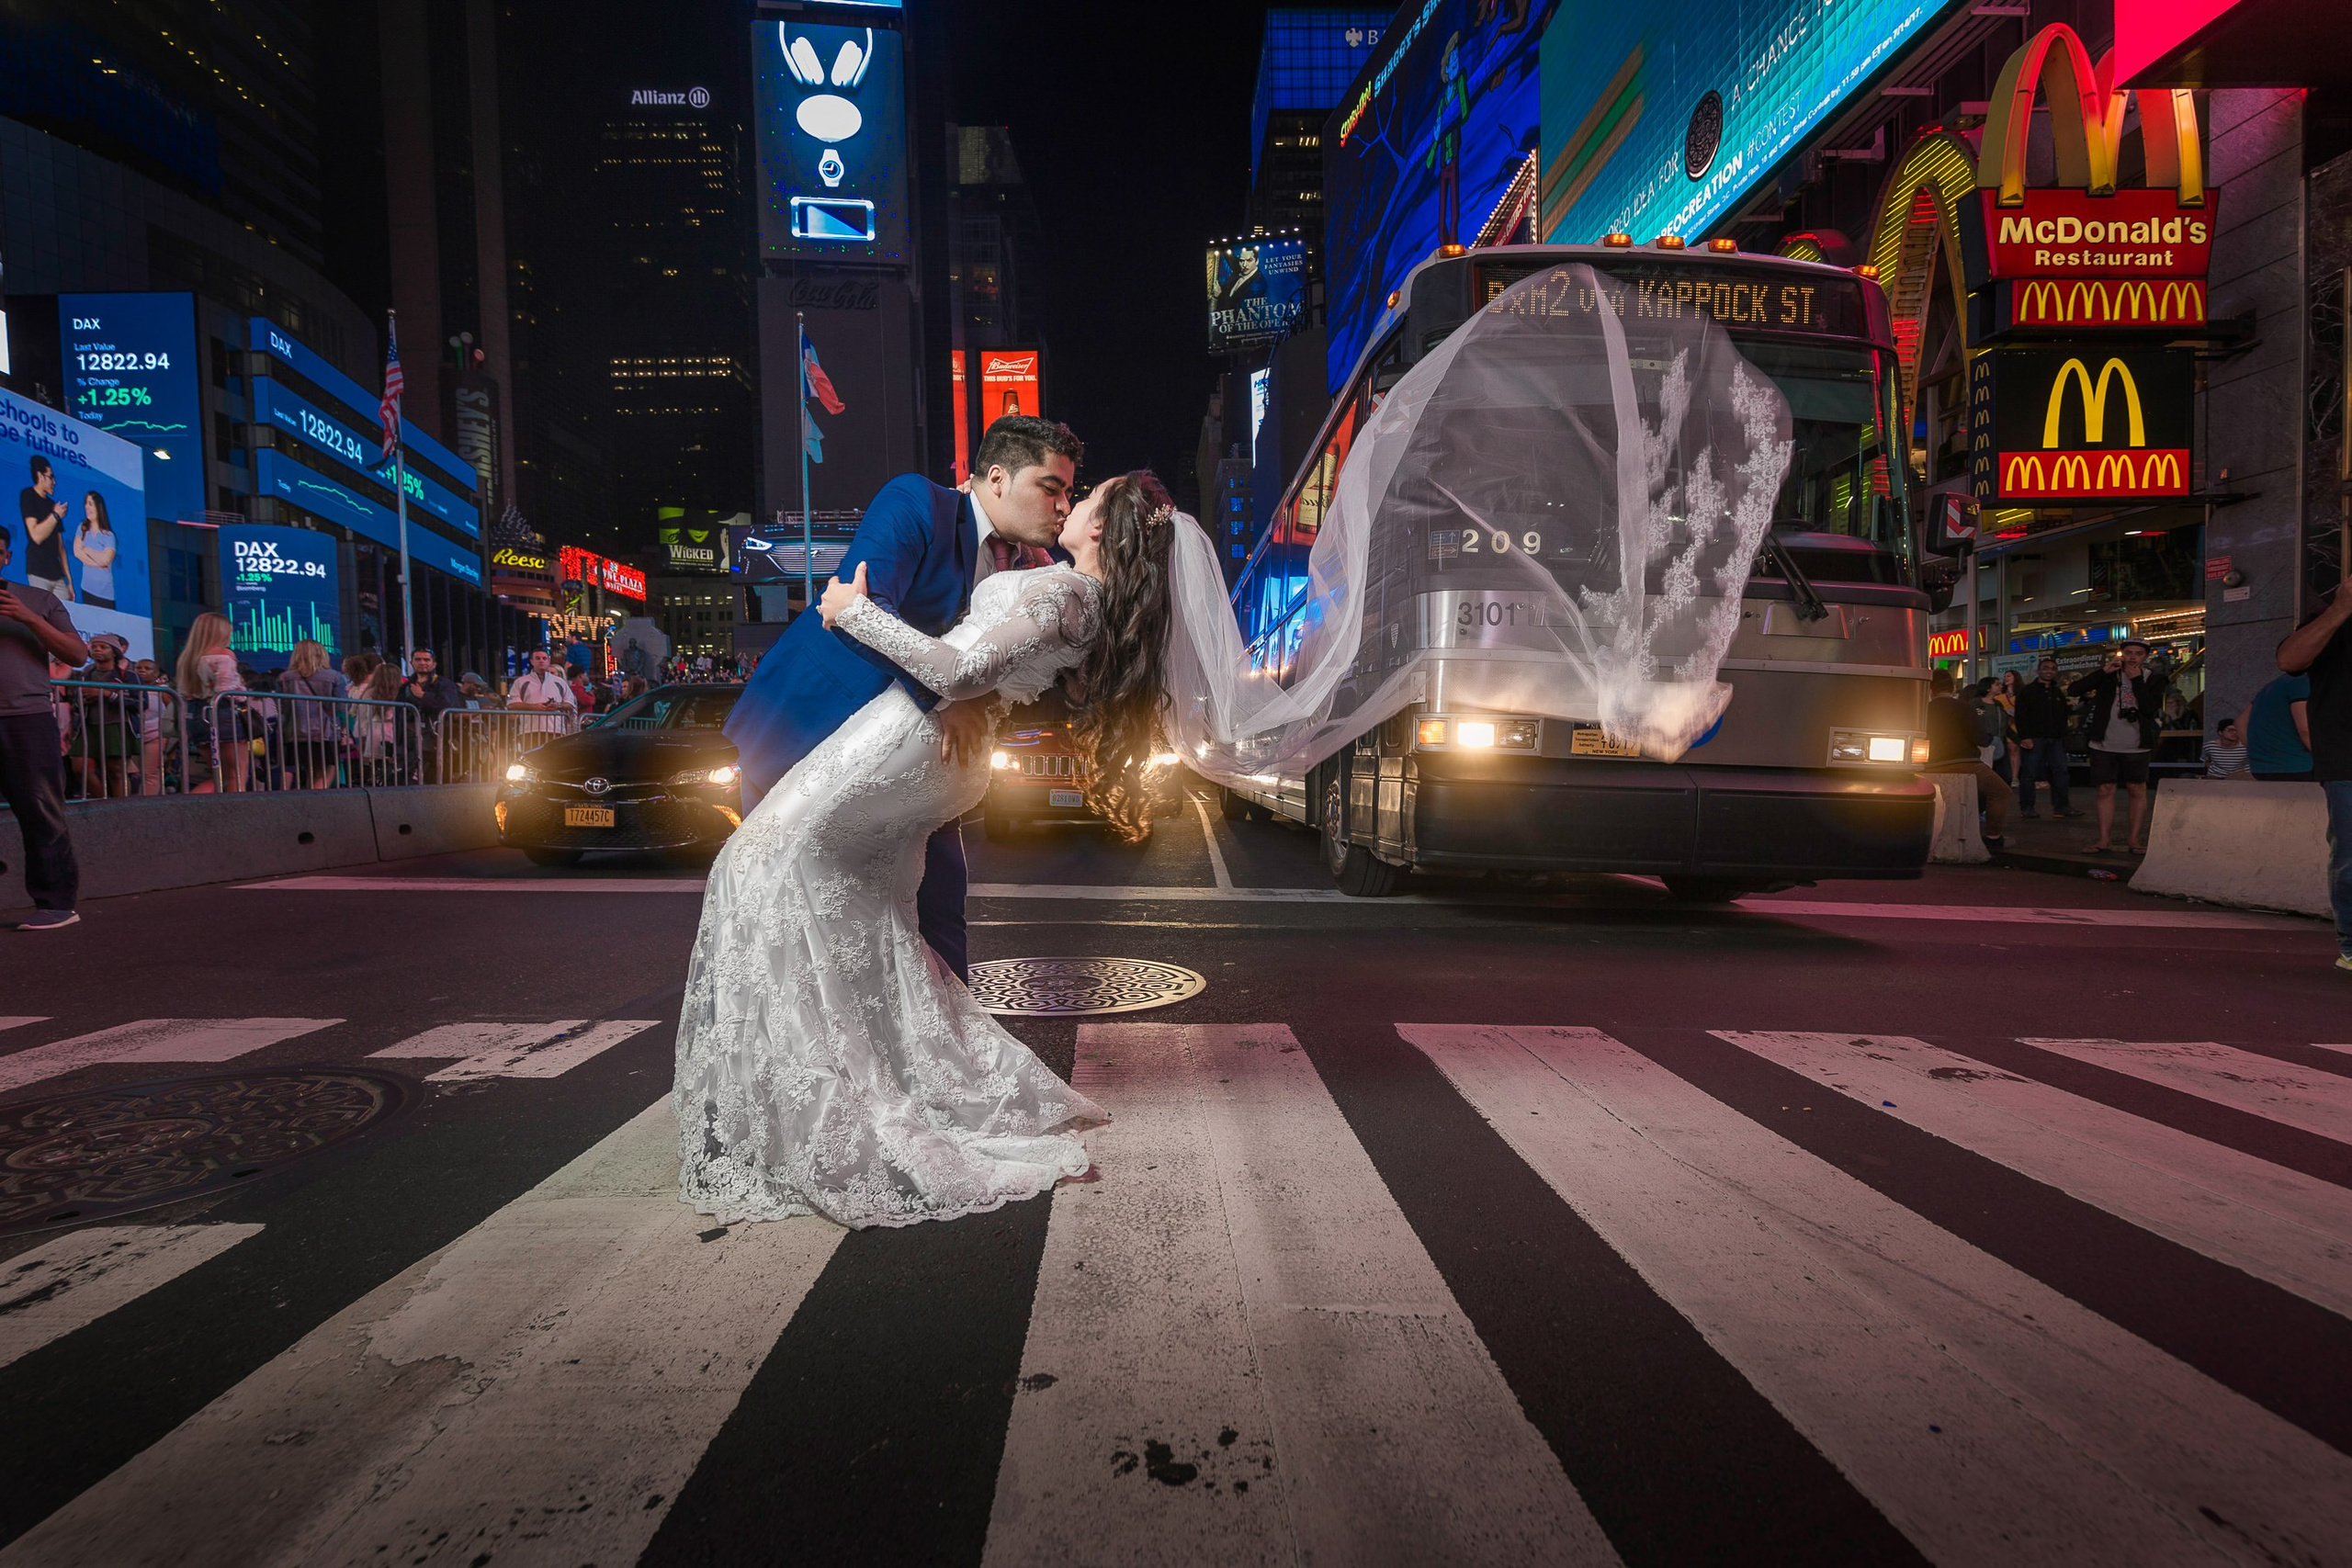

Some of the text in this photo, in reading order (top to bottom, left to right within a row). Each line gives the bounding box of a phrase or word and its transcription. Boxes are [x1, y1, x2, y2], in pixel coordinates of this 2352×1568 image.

[1731, 6, 1807, 111] A CHANCE
[631, 89, 686, 105] Allianz
[1634, 181, 1655, 218] IDEA
[1658, 151, 1679, 190] FOR
[1655, 151, 1743, 240] REOCREATION
[1999, 217, 2207, 244] McDonald's
[1264, 260, 1304, 270] FANTASIES
[1265, 254, 1303, 265] LET YOUR
[2035, 250, 2174, 266] Restaurant
[1268, 266, 1299, 276] UNWIND
[1244, 297, 1268, 308] THE
[1637, 278, 1770, 323] KAPPOCK
[1781, 286, 1815, 324] ST
[73, 318, 101, 330] DAX
[1211, 302, 1302, 328] PHANTOM
[1218, 318, 1289, 333] OF THE OPE
[270, 331, 292, 358] DAX
[76, 353, 170, 370] 12822.94
[989, 361, 1029, 370] Budweiser
[88, 377, 119, 387] Change
[77, 387, 152, 405] +1.25%
[78, 412, 103, 422] Today
[61, 423, 79, 446] to
[300, 409, 363, 465] 12822.94
[25, 428, 92, 469] futures.
[456, 388, 494, 505] RSHEY'S
[386, 464, 424, 501] +125%
[233, 540, 279, 558] DAX
[235, 557, 327, 579] 12822.94
[619, 574, 643, 592] PLAZA
[1457, 602, 1515, 626] 3101
[2055, 653, 2103, 665] Extraordinary
[2057, 661, 2101, 671] sandwiches.
[210, 728, 220, 767] NYPD
[570, 809, 610, 823] T724457C
